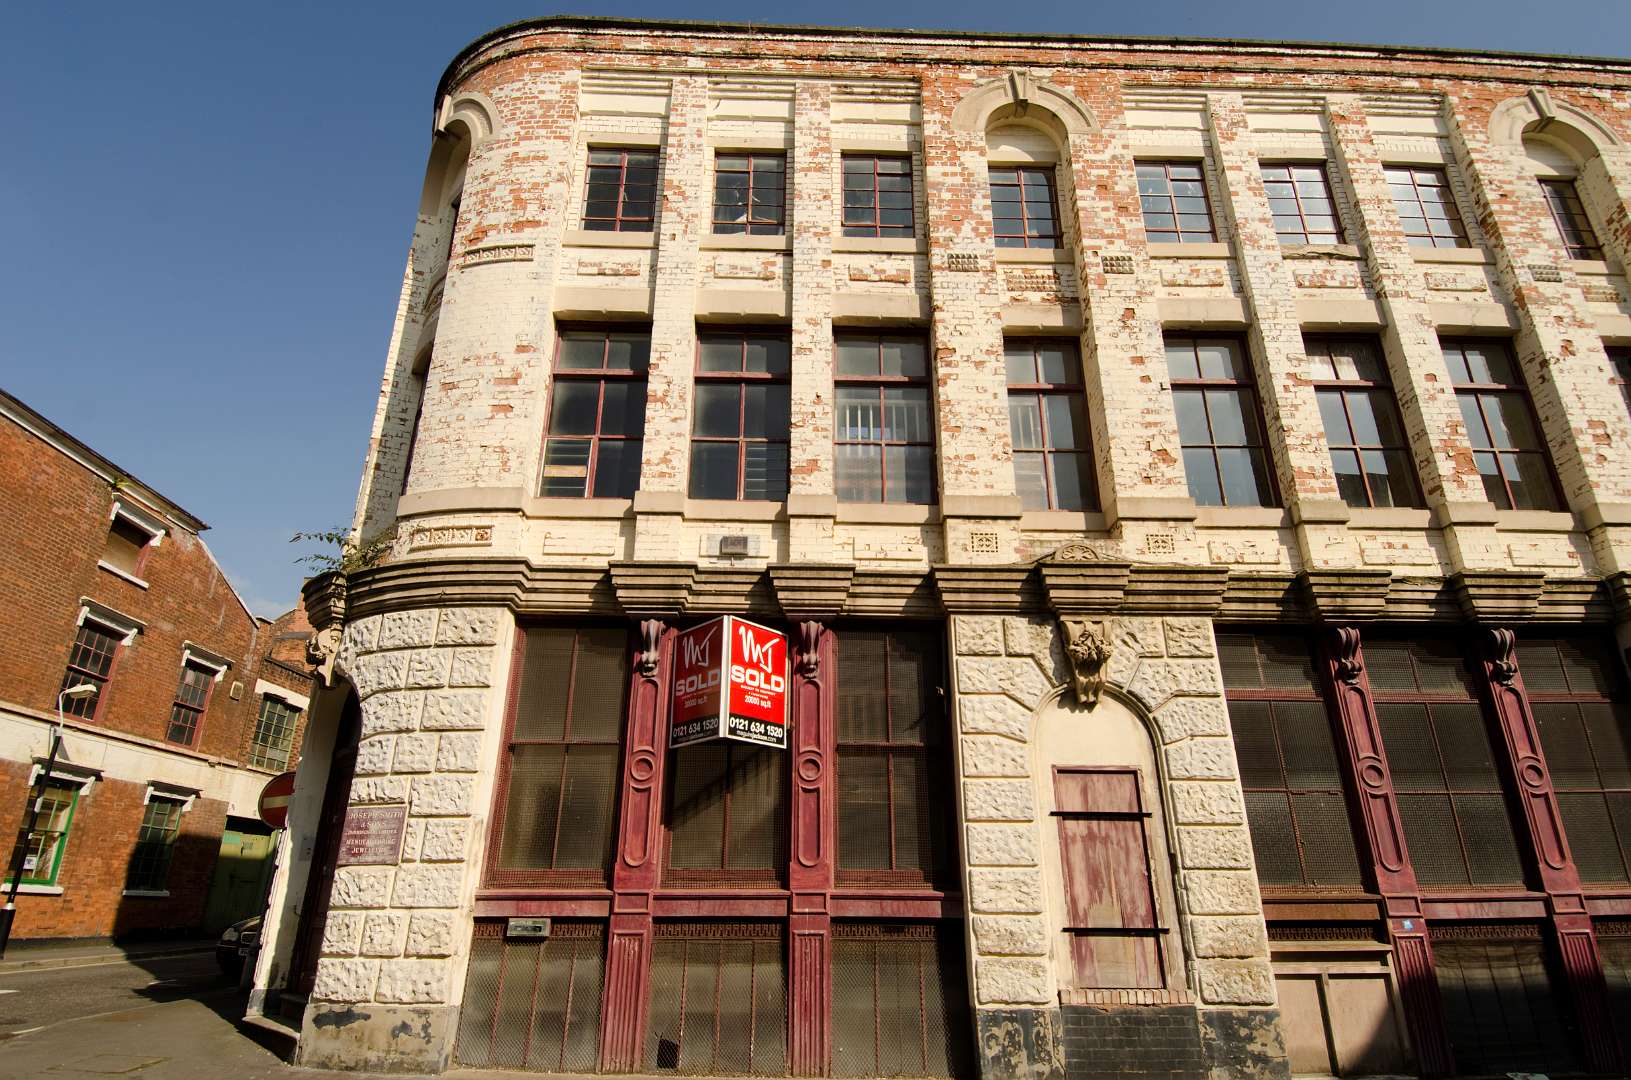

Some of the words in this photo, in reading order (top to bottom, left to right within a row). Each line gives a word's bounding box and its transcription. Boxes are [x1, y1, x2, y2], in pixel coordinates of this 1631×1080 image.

[675, 668, 720, 696] SOLD
[731, 665, 784, 692] SOLD
[673, 725, 687, 738] 0121
[688, 721, 701, 734] 634
[702, 717, 719, 731] 1520
[729, 717, 749, 731] 0121
[750, 721, 765, 735] 634
[766, 724, 783, 738] 1520
[379, 811, 403, 819] SMITH
